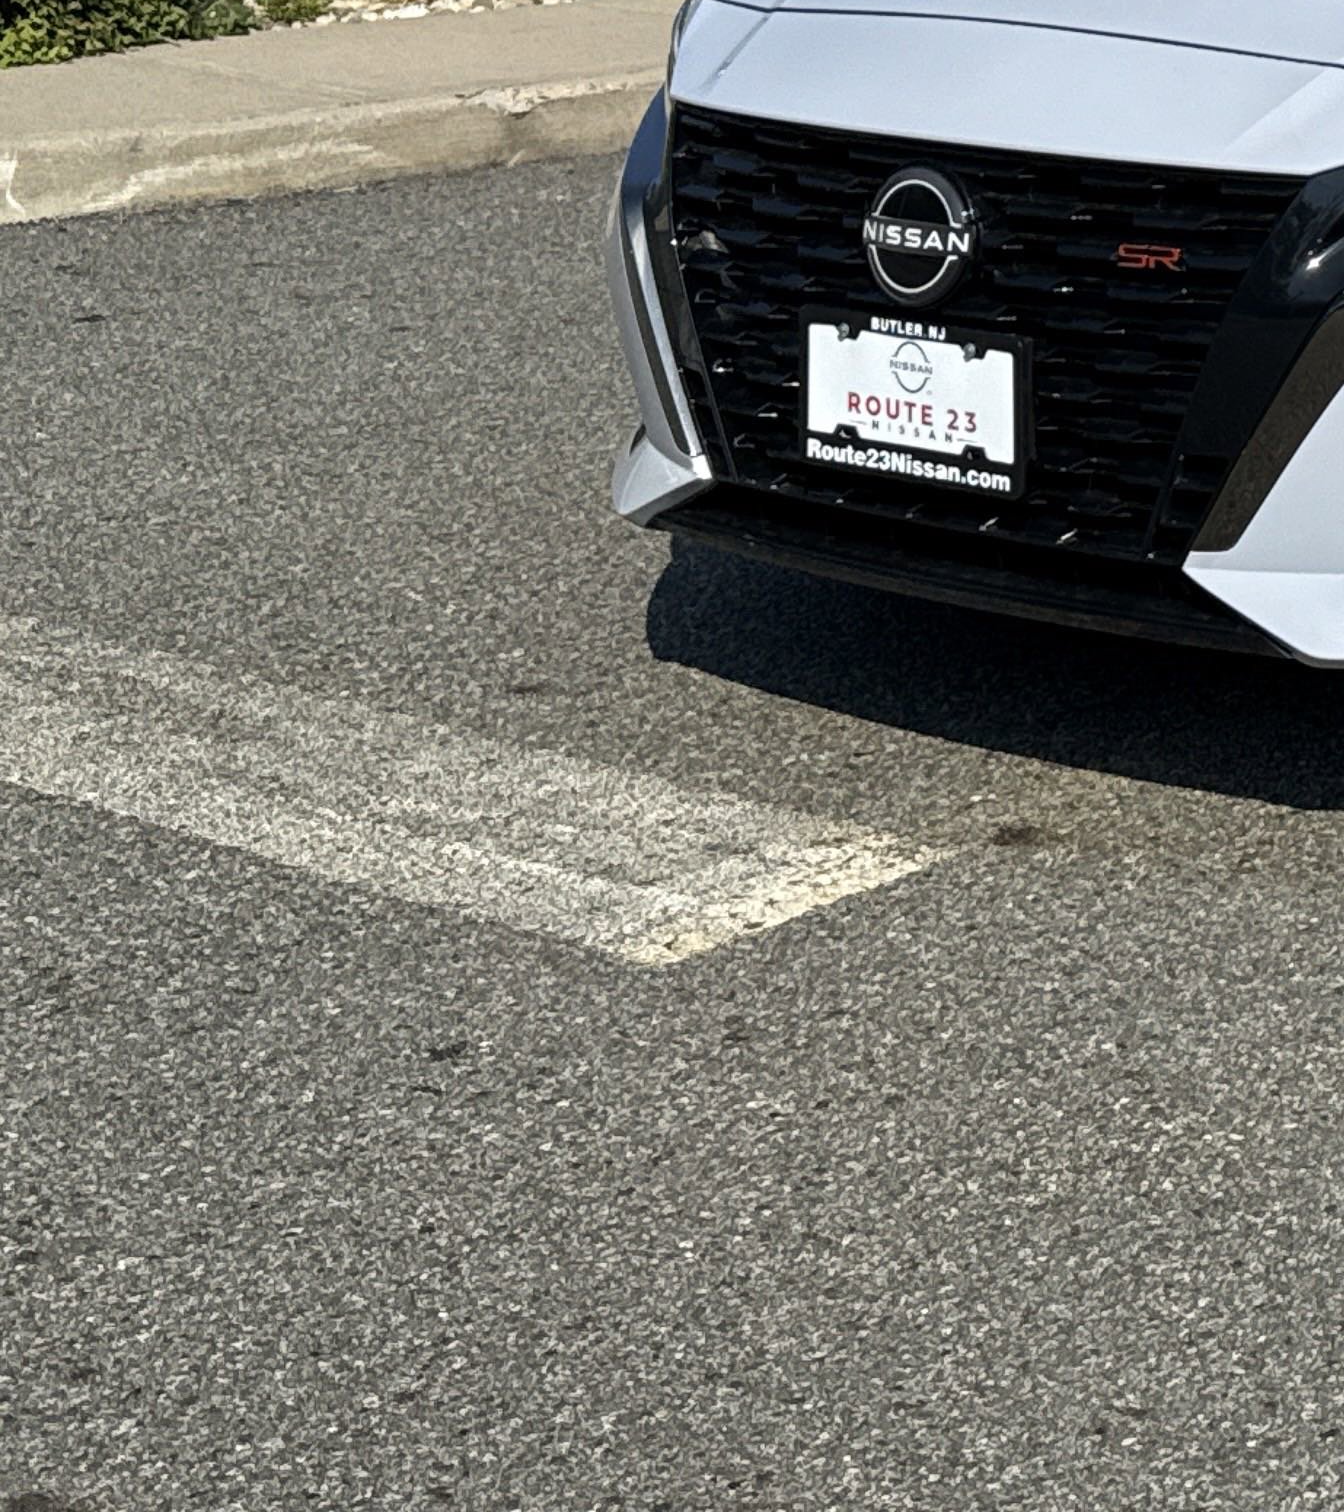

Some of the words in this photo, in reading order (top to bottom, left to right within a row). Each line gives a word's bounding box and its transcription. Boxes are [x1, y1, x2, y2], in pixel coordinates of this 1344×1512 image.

[862, 218, 970, 253] NISSAN
[1117, 243, 1182, 271] SR
[928, 325, 946, 341] NJ
[889, 359, 934, 375] NISSAN
[847, 391, 933, 426] ROUTE
[946, 409, 977, 433] 23
[871, 419, 953, 443] NISSAN
[807, 438, 1011, 492] Route23Nissan.com
